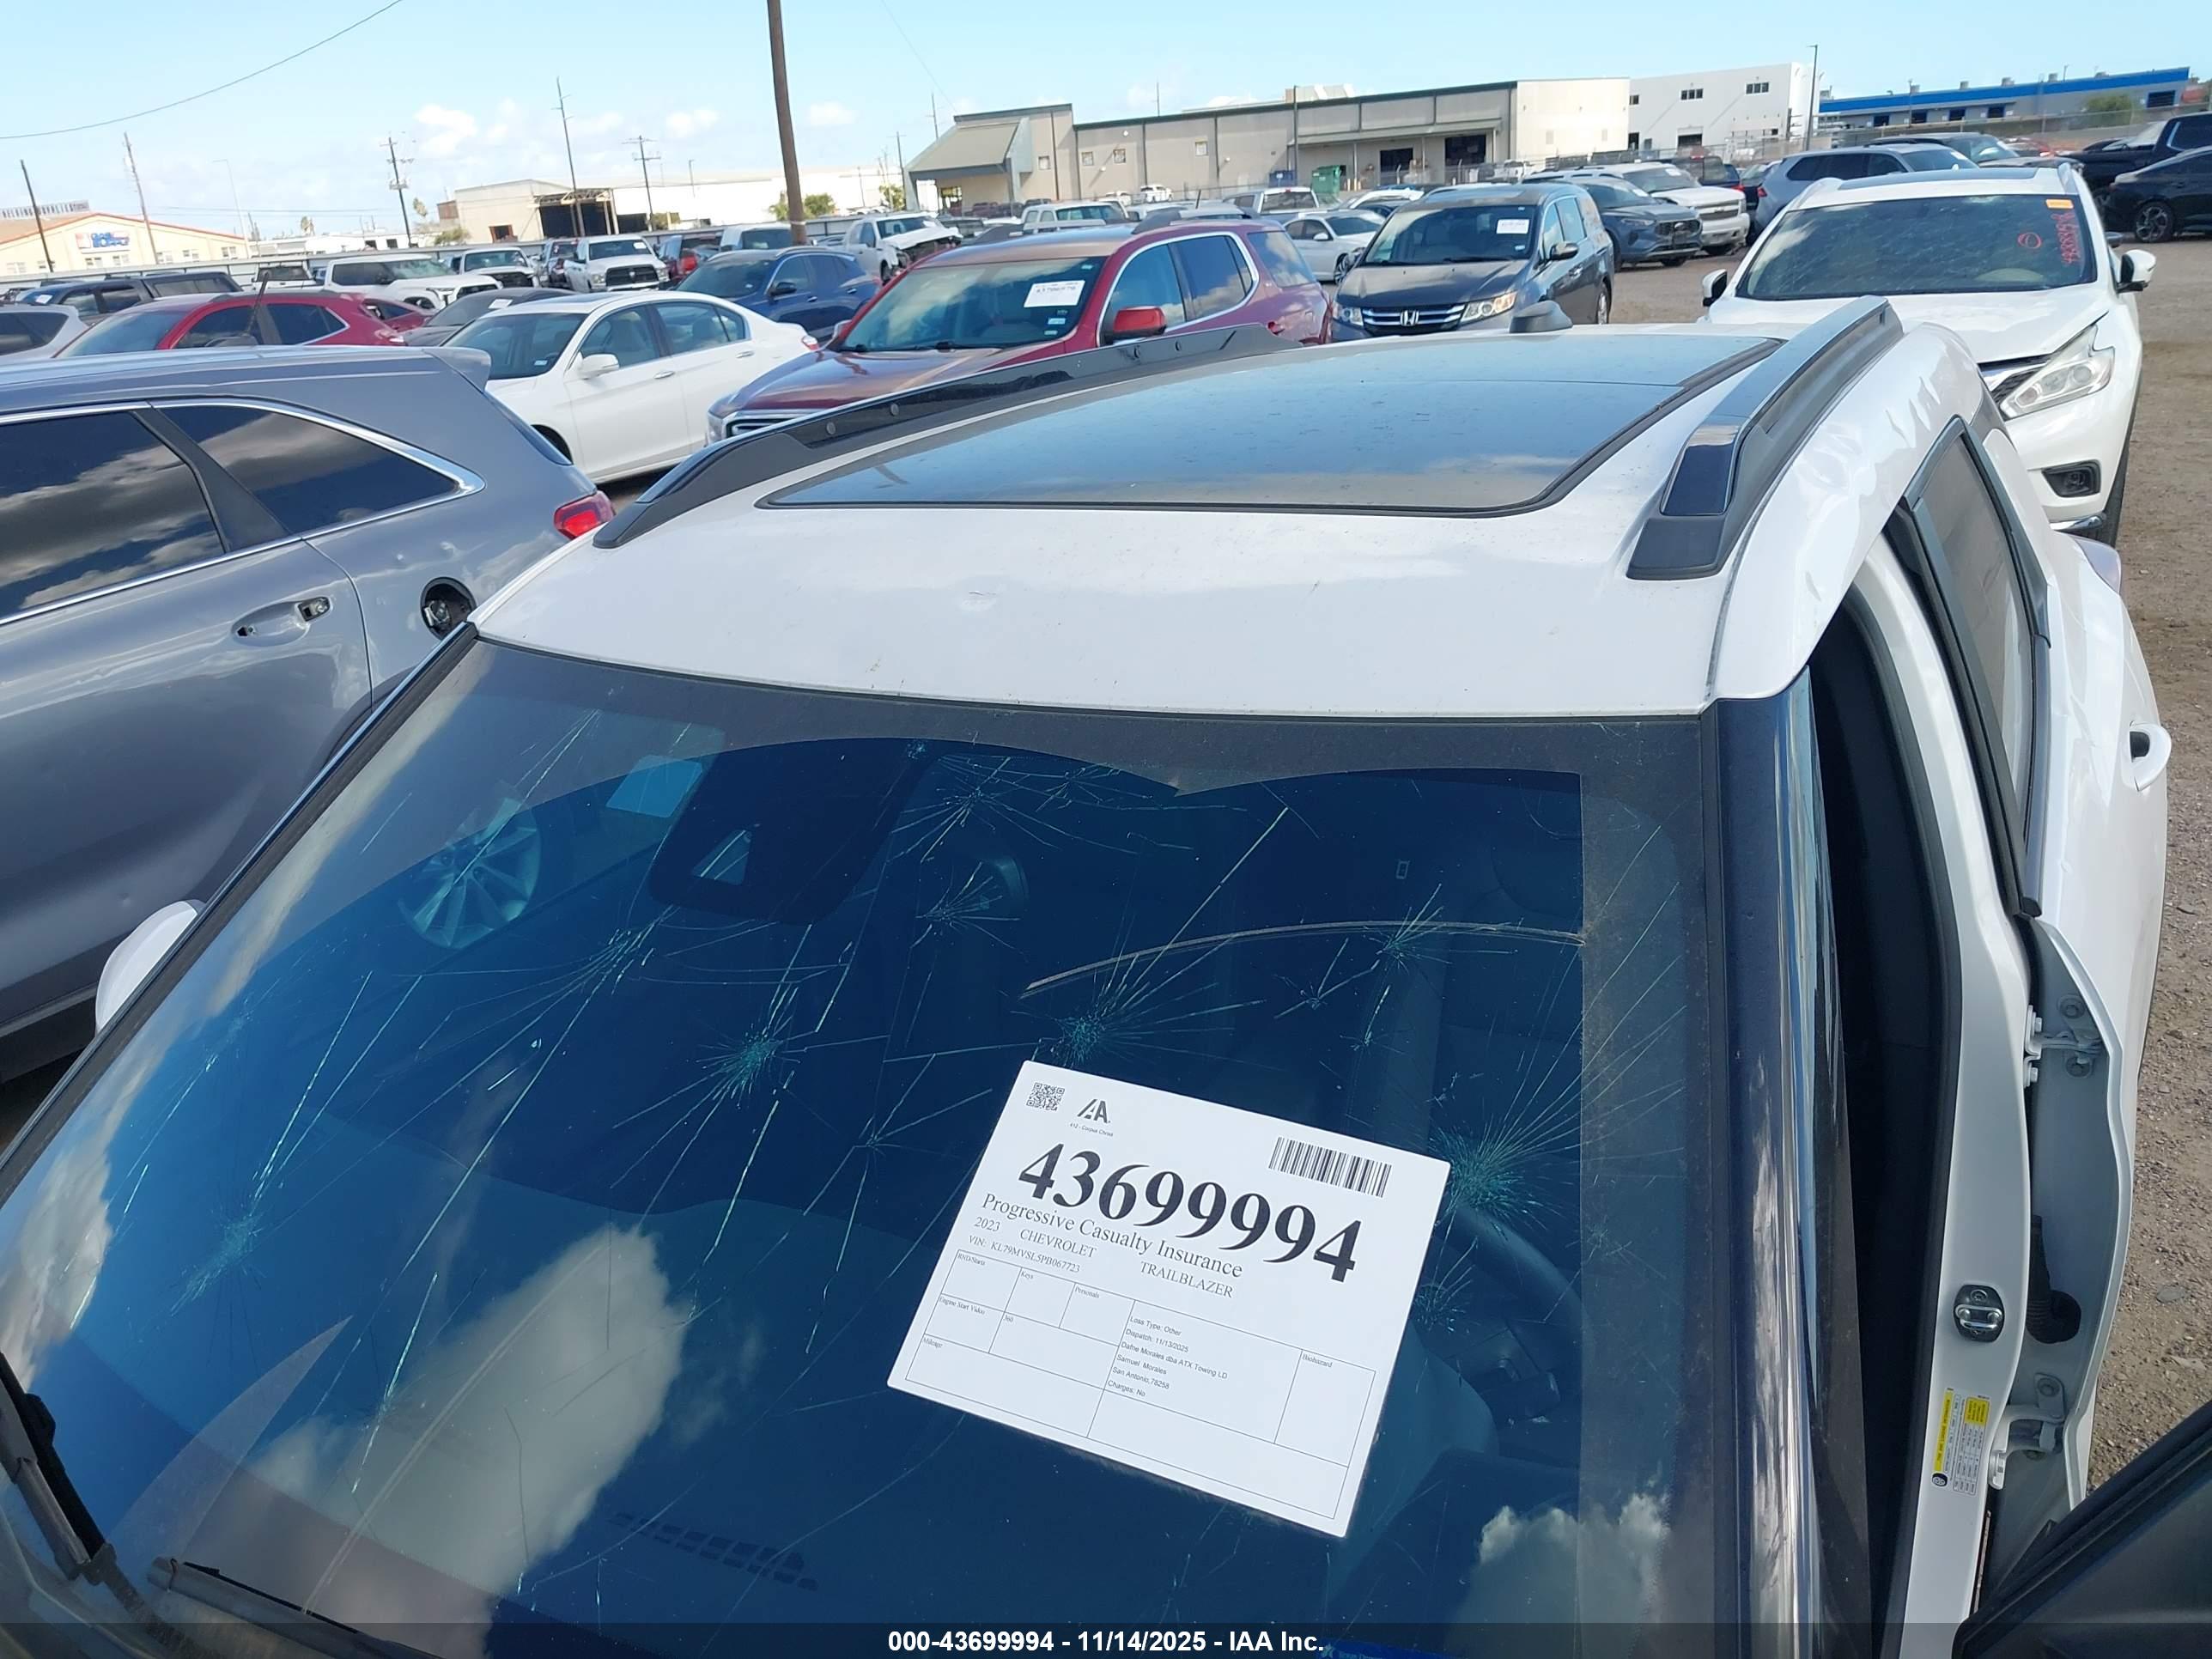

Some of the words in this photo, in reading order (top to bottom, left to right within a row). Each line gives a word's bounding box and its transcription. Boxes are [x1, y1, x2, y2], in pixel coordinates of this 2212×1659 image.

[1018, 1143, 1362, 1283] 43699994
[982, 1194, 1075, 1231] Progressive
[1079, 1219, 1153, 1255] Casualty
[1157, 1239, 1243, 1278] Insurance
[969, 1235, 987, 1248] VIN:
[990, 1241, 1081, 1273] KL79MVSL5PB067723
[974, 1217, 1000, 1231] 2023
[1020, 1229, 1097, 1257] CHEVROLET
[1140, 1261, 1234, 1298] TRAILBLAZER
[1020, 1271, 1034, 1279] Keys
[1074, 1286, 1100, 1299] Personals
[939, 1296, 957, 1307] Engine
[957, 1301, 969, 1310] Start
[970, 1304, 986, 1315] Video
[1129, 1316, 1145, 1326] Loss
[1146, 1320, 1163, 1331] Type:
[1164, 1326, 1182, 1336] Other
[923, 1337, 943, 1349] Mileage
[1125, 1328, 1153, 1342] Dispatch:
[1155, 1338, 1189, 1352] 11/13/2025
[1112, 1366, 1125, 1375] San
[1116, 1354, 1140, 1367] Samuel
[1142, 1362, 1167, 1375] Morales
[1140, 1347, 1164, 1360] Morales
[1165, 1355, 1177, 1364] dba
[1178, 1359, 1194, 1369] ATX
[1194, 1364, 1217, 1377] Towing
[1302, 1353, 1333, 1368] Biohazard
[1108, 1379, 1134, 1394] Charges:
[1136, 1389, 1146, 1397] No
